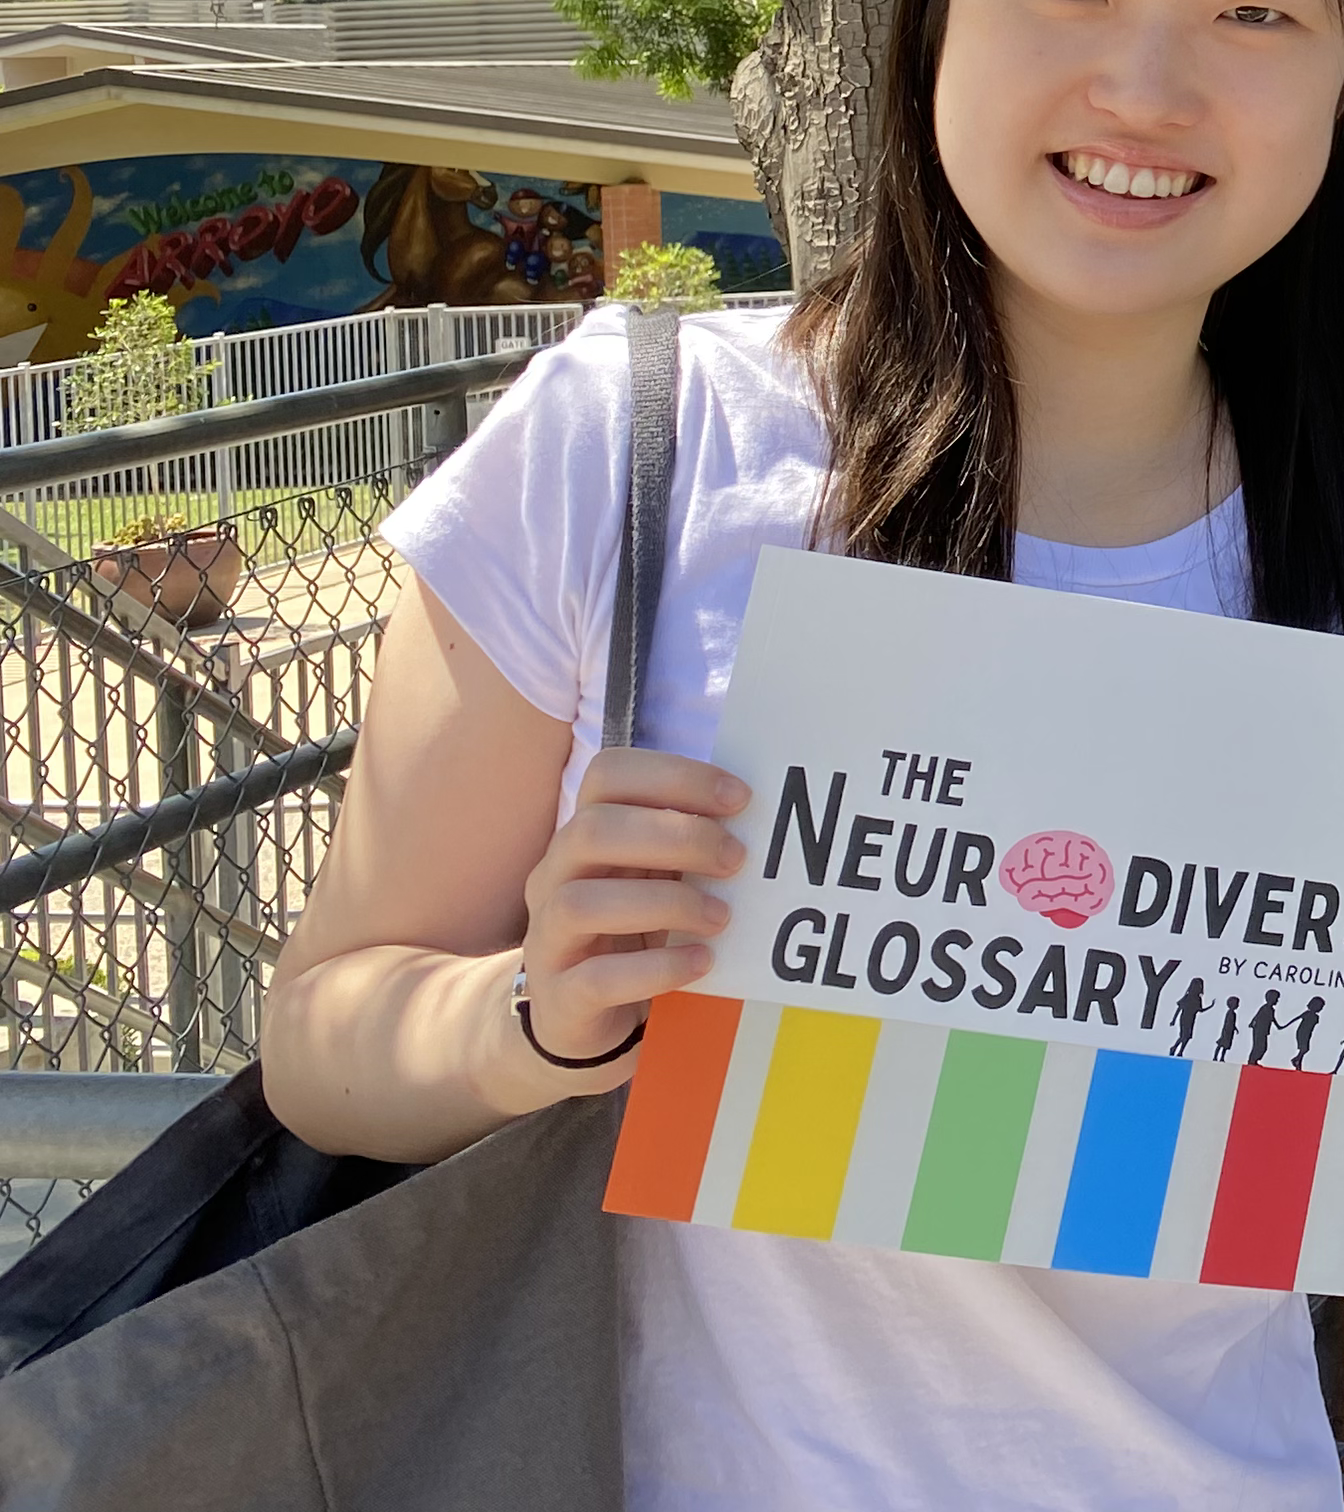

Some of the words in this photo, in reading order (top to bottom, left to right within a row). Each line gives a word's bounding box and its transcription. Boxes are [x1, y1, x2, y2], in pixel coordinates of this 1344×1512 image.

[128, 180, 258, 236] Welcome
[257, 169, 294, 197] to
[104, 176, 360, 301] ARROYO
[501, 340, 524, 349] GATE
[881, 749, 972, 807] THE
[763, 766, 996, 907] NEUR
[771, 907, 1183, 1030] GLOSSARY
[1218, 956, 1248, 976] BY
